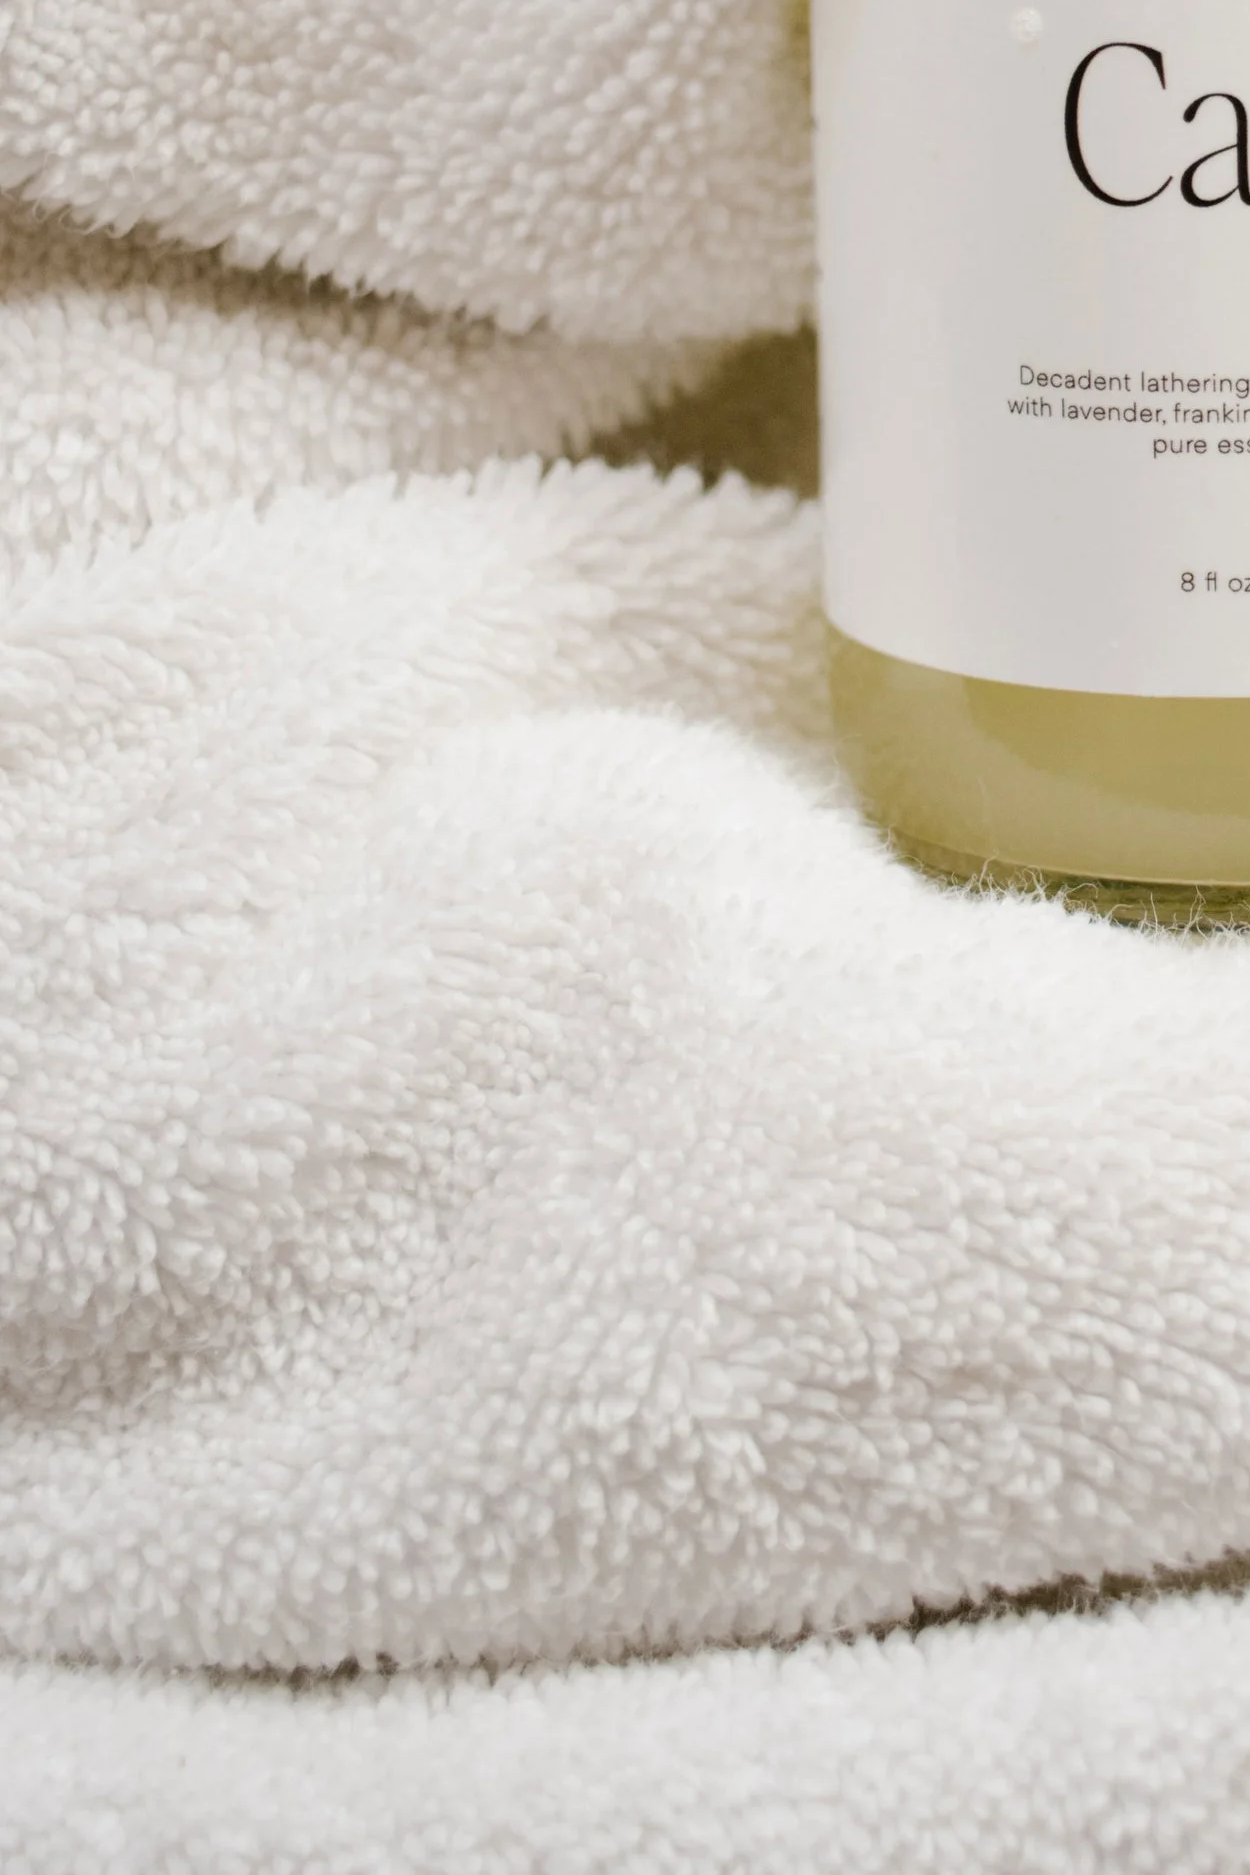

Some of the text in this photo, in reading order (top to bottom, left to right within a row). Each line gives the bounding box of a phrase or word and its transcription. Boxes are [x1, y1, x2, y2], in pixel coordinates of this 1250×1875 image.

[1020, 365, 1131, 392] Decadent
[1141, 371, 1250, 398] lathering
[1008, 397, 1052, 417] with
[1062, 398, 1166, 425] lavender,
[1153, 439, 1207, 459] pure
[1181, 572, 1195, 592] 8
[1204, 571, 1217, 592] fl
